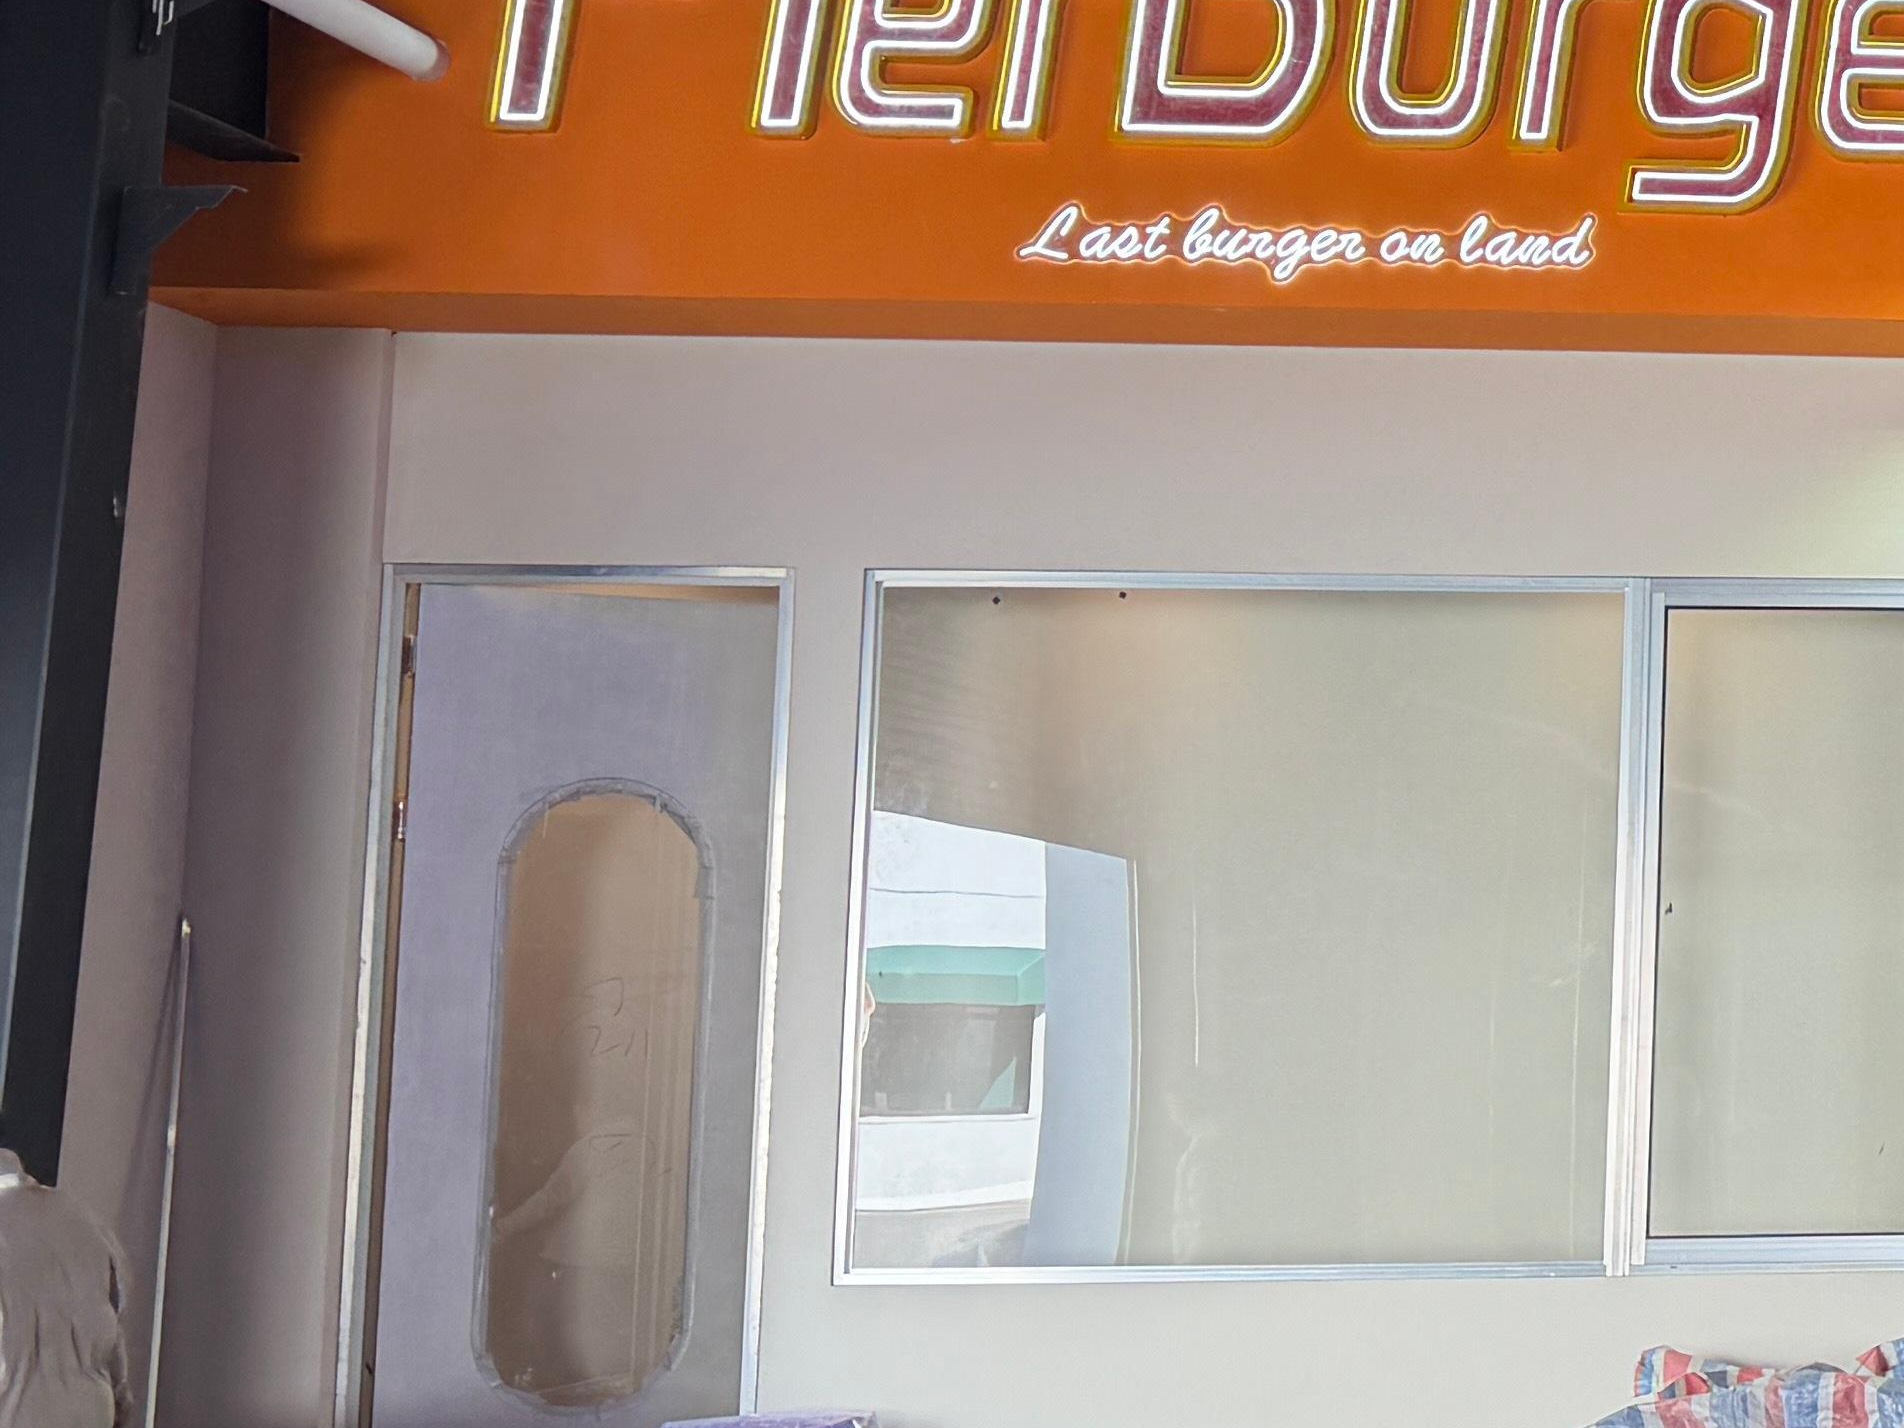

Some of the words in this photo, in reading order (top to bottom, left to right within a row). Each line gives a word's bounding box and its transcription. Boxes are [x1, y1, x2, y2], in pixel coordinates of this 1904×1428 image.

[1018, 204, 1171, 261] Last
[1183, 203, 1367, 280] burger
[1379, 229, 1445, 263] on
[1459, 213, 1594, 266] land
